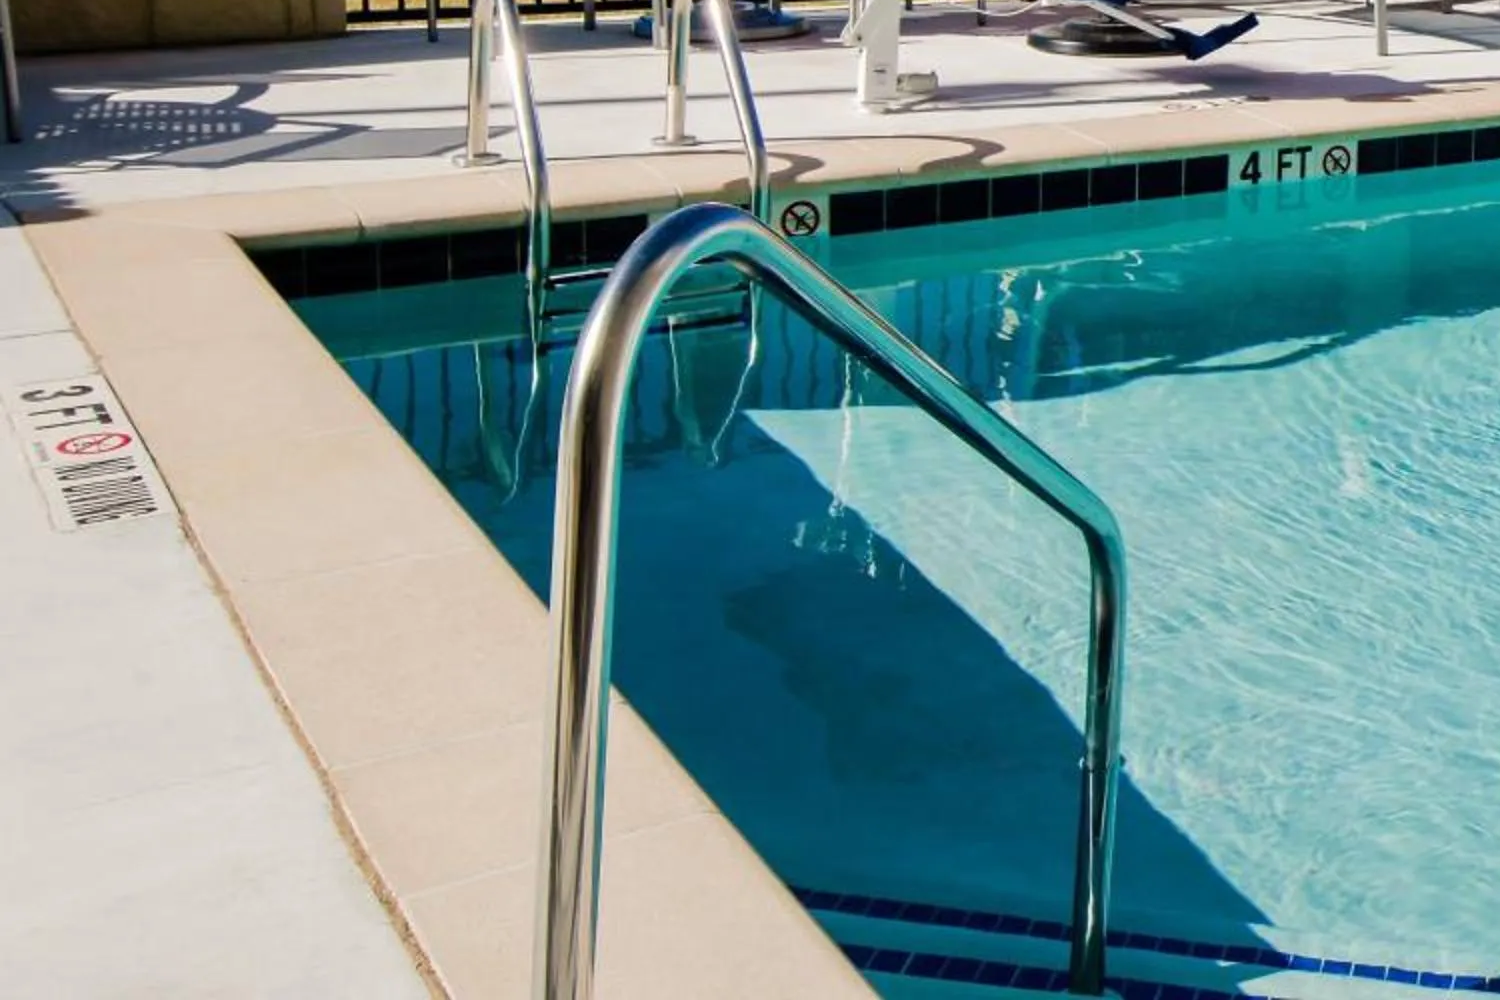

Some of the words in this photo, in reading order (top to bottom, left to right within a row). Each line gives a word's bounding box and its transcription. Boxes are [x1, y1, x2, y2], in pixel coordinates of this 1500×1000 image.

[1239, 151, 1261, 185] 4
[1277, 145, 1313, 183] FT
[20, 385, 94, 402] 3
[28, 403, 113, 430] FT
